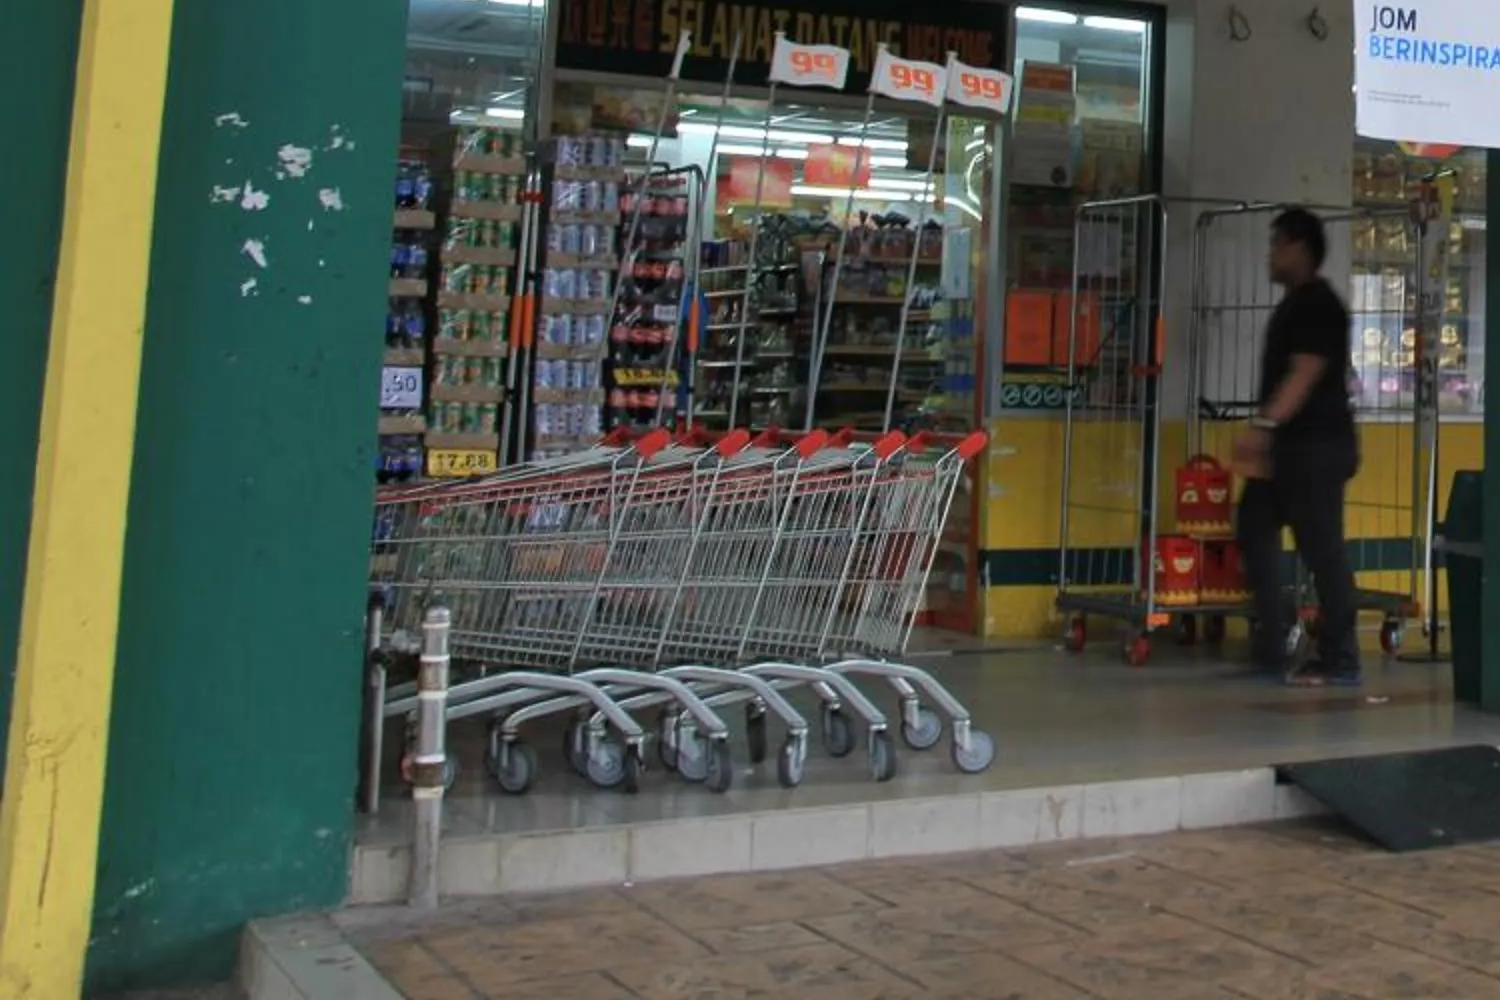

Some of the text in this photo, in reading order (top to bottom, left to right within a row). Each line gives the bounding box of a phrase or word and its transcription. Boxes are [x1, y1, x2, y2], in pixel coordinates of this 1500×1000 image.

[1370, 4, 1417, 33] JOM
[789, 50, 838, 81] 99
[889, 64, 935, 95] 99
[960, 72, 1004, 99] 99
